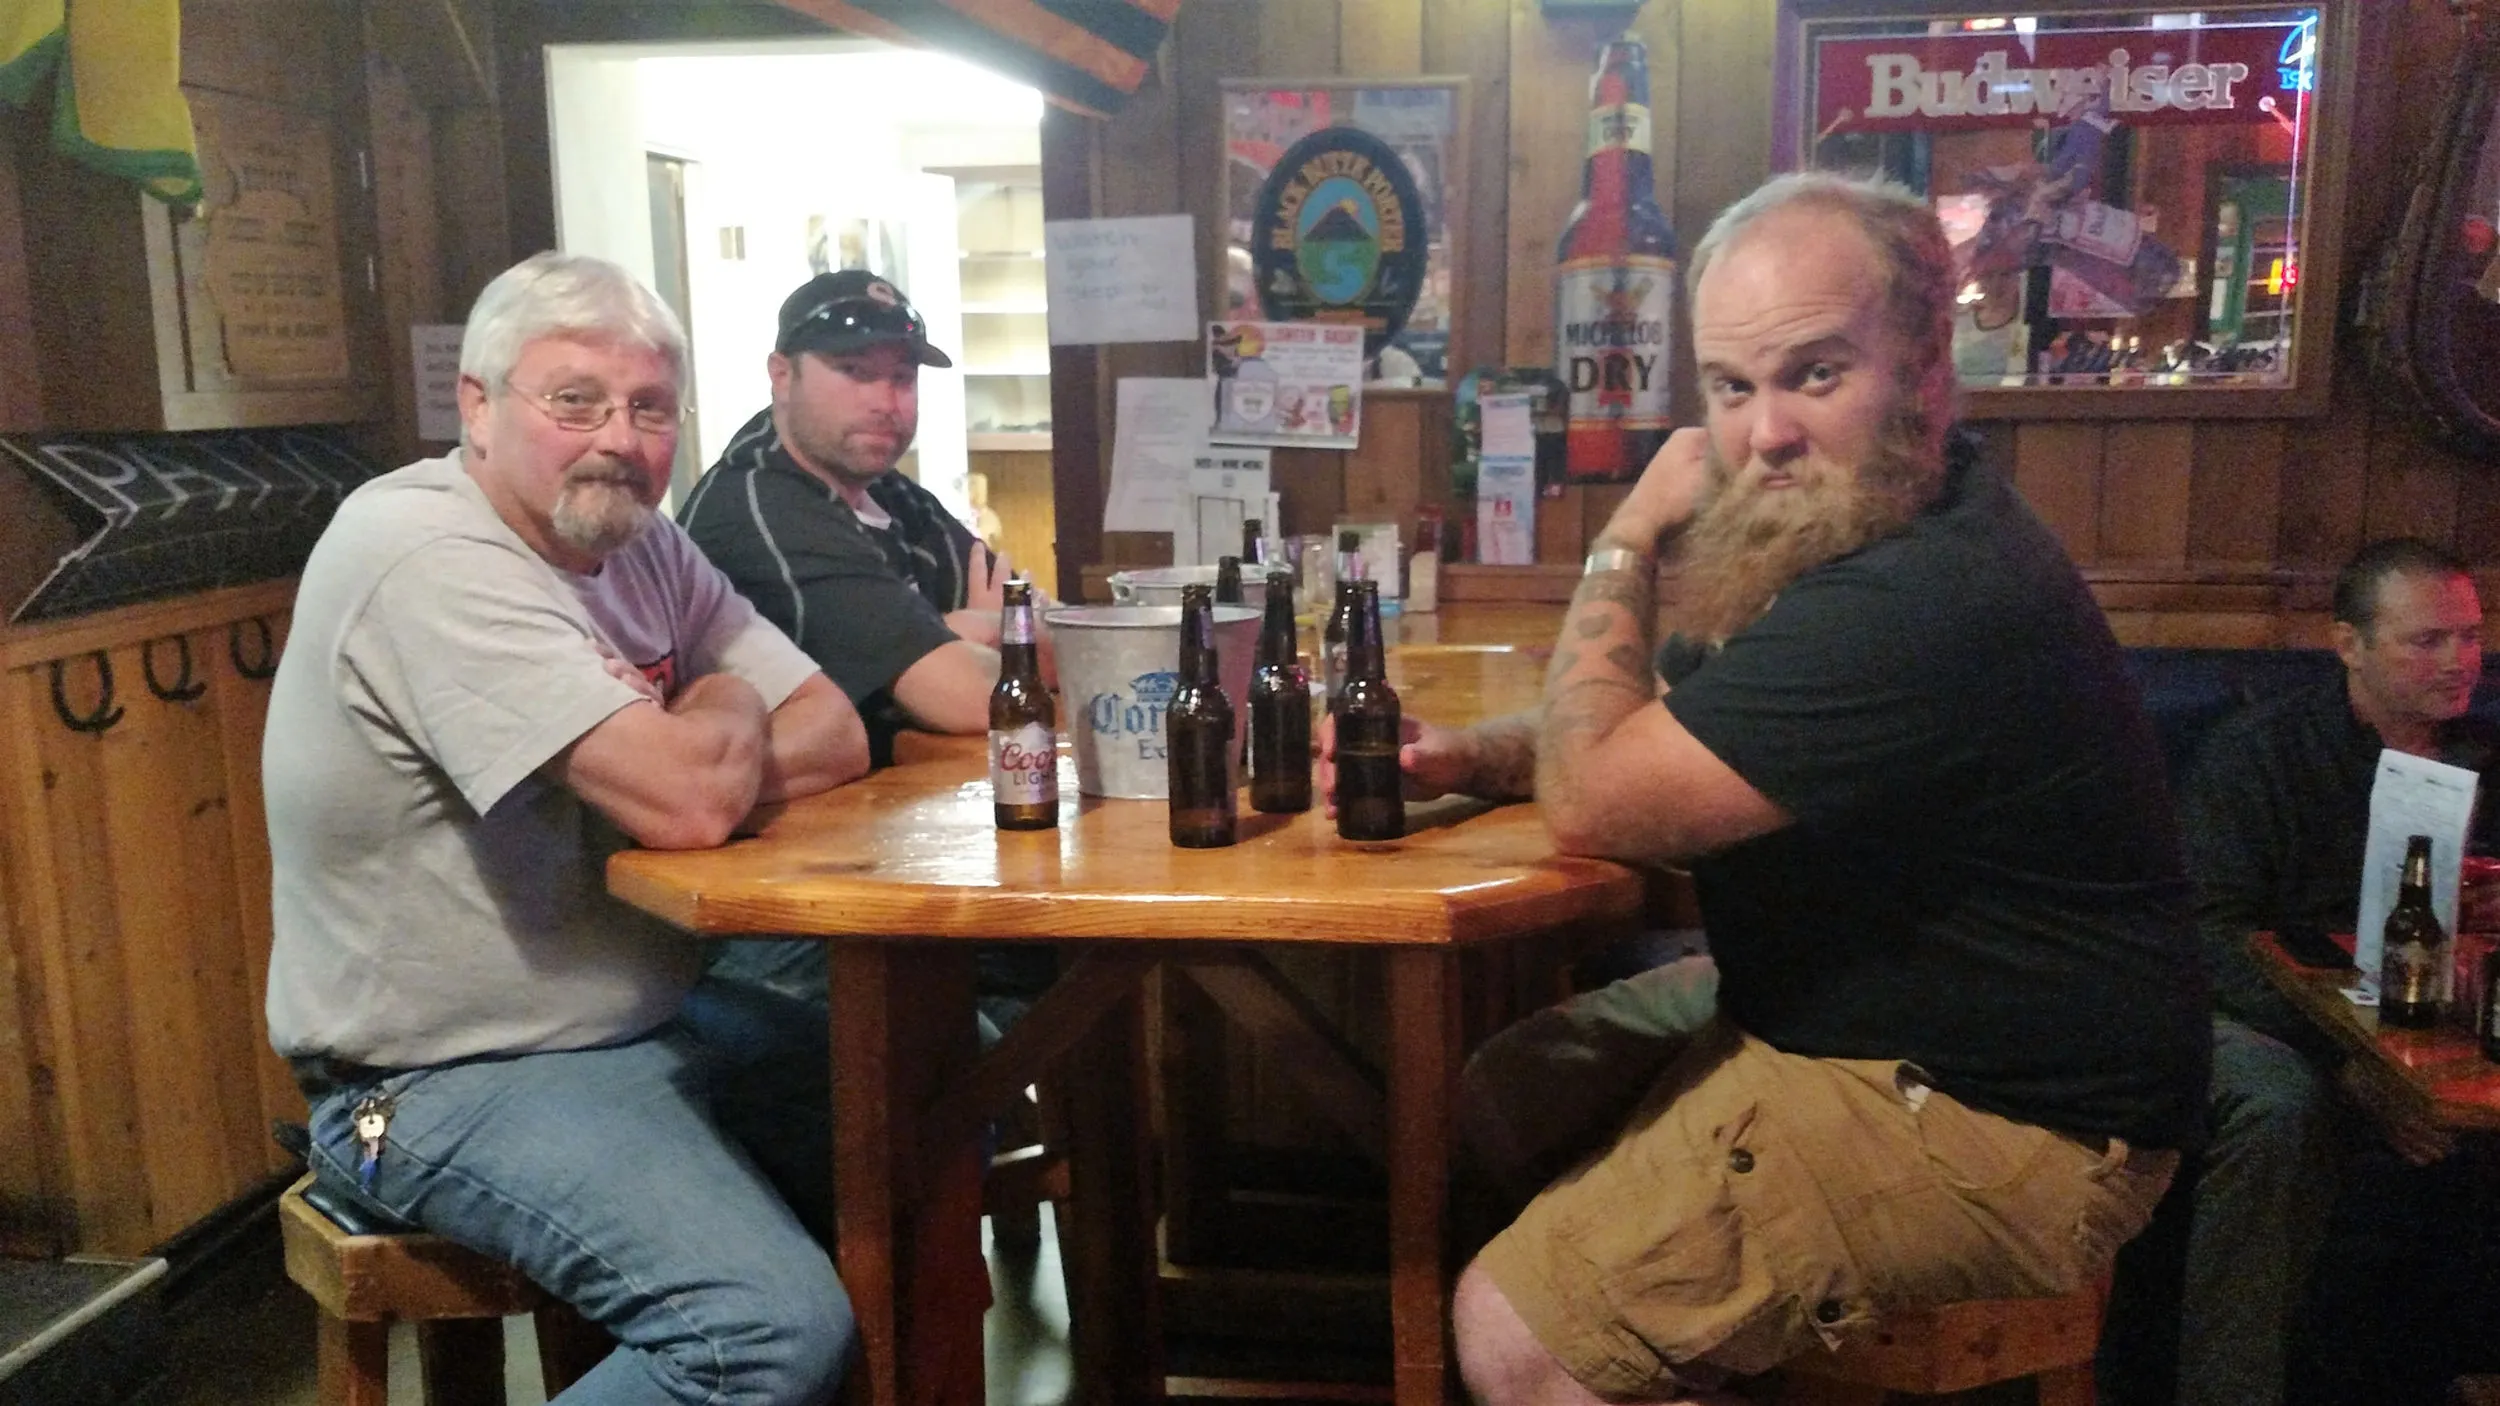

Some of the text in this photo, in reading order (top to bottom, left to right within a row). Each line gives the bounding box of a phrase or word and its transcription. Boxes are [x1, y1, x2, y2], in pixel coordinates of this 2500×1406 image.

[1864, 47, 2249, 118] Budweiser
[1569, 354, 1658, 393] DRY
[1090, 694, 1168, 739] Cor
[1139, 739, 1168, 761] Ex
